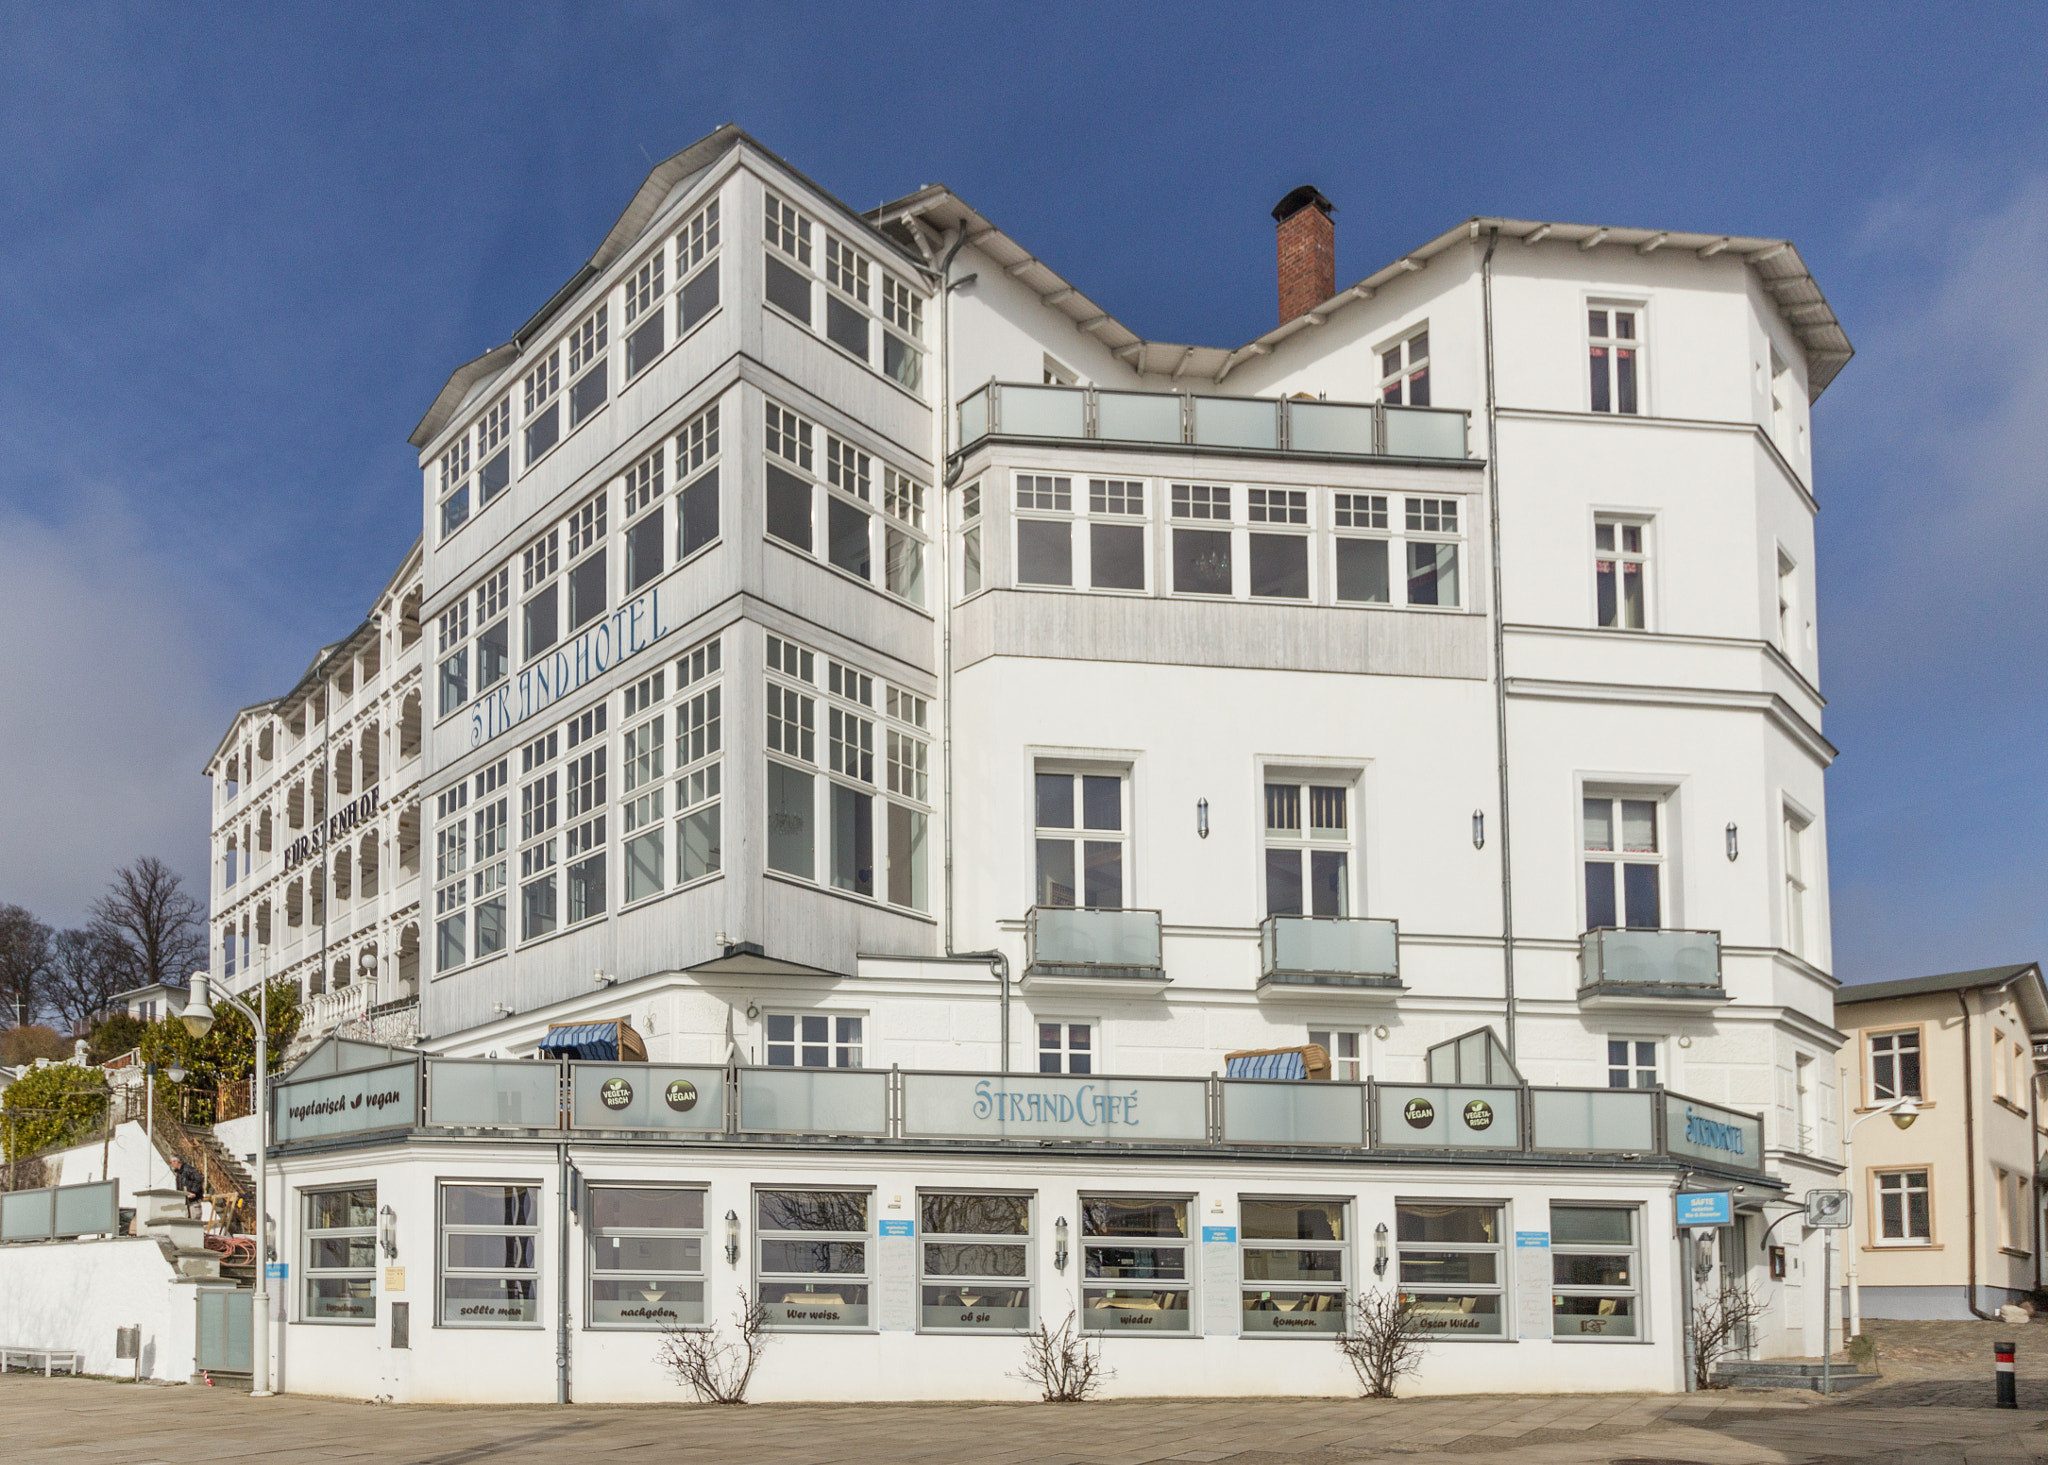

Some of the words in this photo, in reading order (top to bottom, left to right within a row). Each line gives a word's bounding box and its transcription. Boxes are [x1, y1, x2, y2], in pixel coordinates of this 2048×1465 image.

[471, 587, 667, 748] STRANDHOTEL
[602, 1089, 631, 1099] VEGETA-
[667, 1091, 696, 1102] VEGAN
[289, 1094, 346, 1122] vegetarisch
[366, 1091, 400, 1110] vegan
[607, 1096, 629, 1106] RISCH
[1405, 1109, 1433, 1120] VEGAN
[1469, 1118, 1490, 1127] RISCH
[460, 1305, 495, 1316] sollte
[497, 1308, 522, 1316] man
[787, 1309, 807, 1319] Wer
[960, 1310, 973, 1322] ob
[976, 1311, 991, 1323] sie
[1120, 1314, 1153, 1325] wieder
[1272, 1316, 1318, 1328] kommen.
[1420, 1318, 1448, 1329] Oscar
[1450, 1318, 1480, 1329] Wilde
